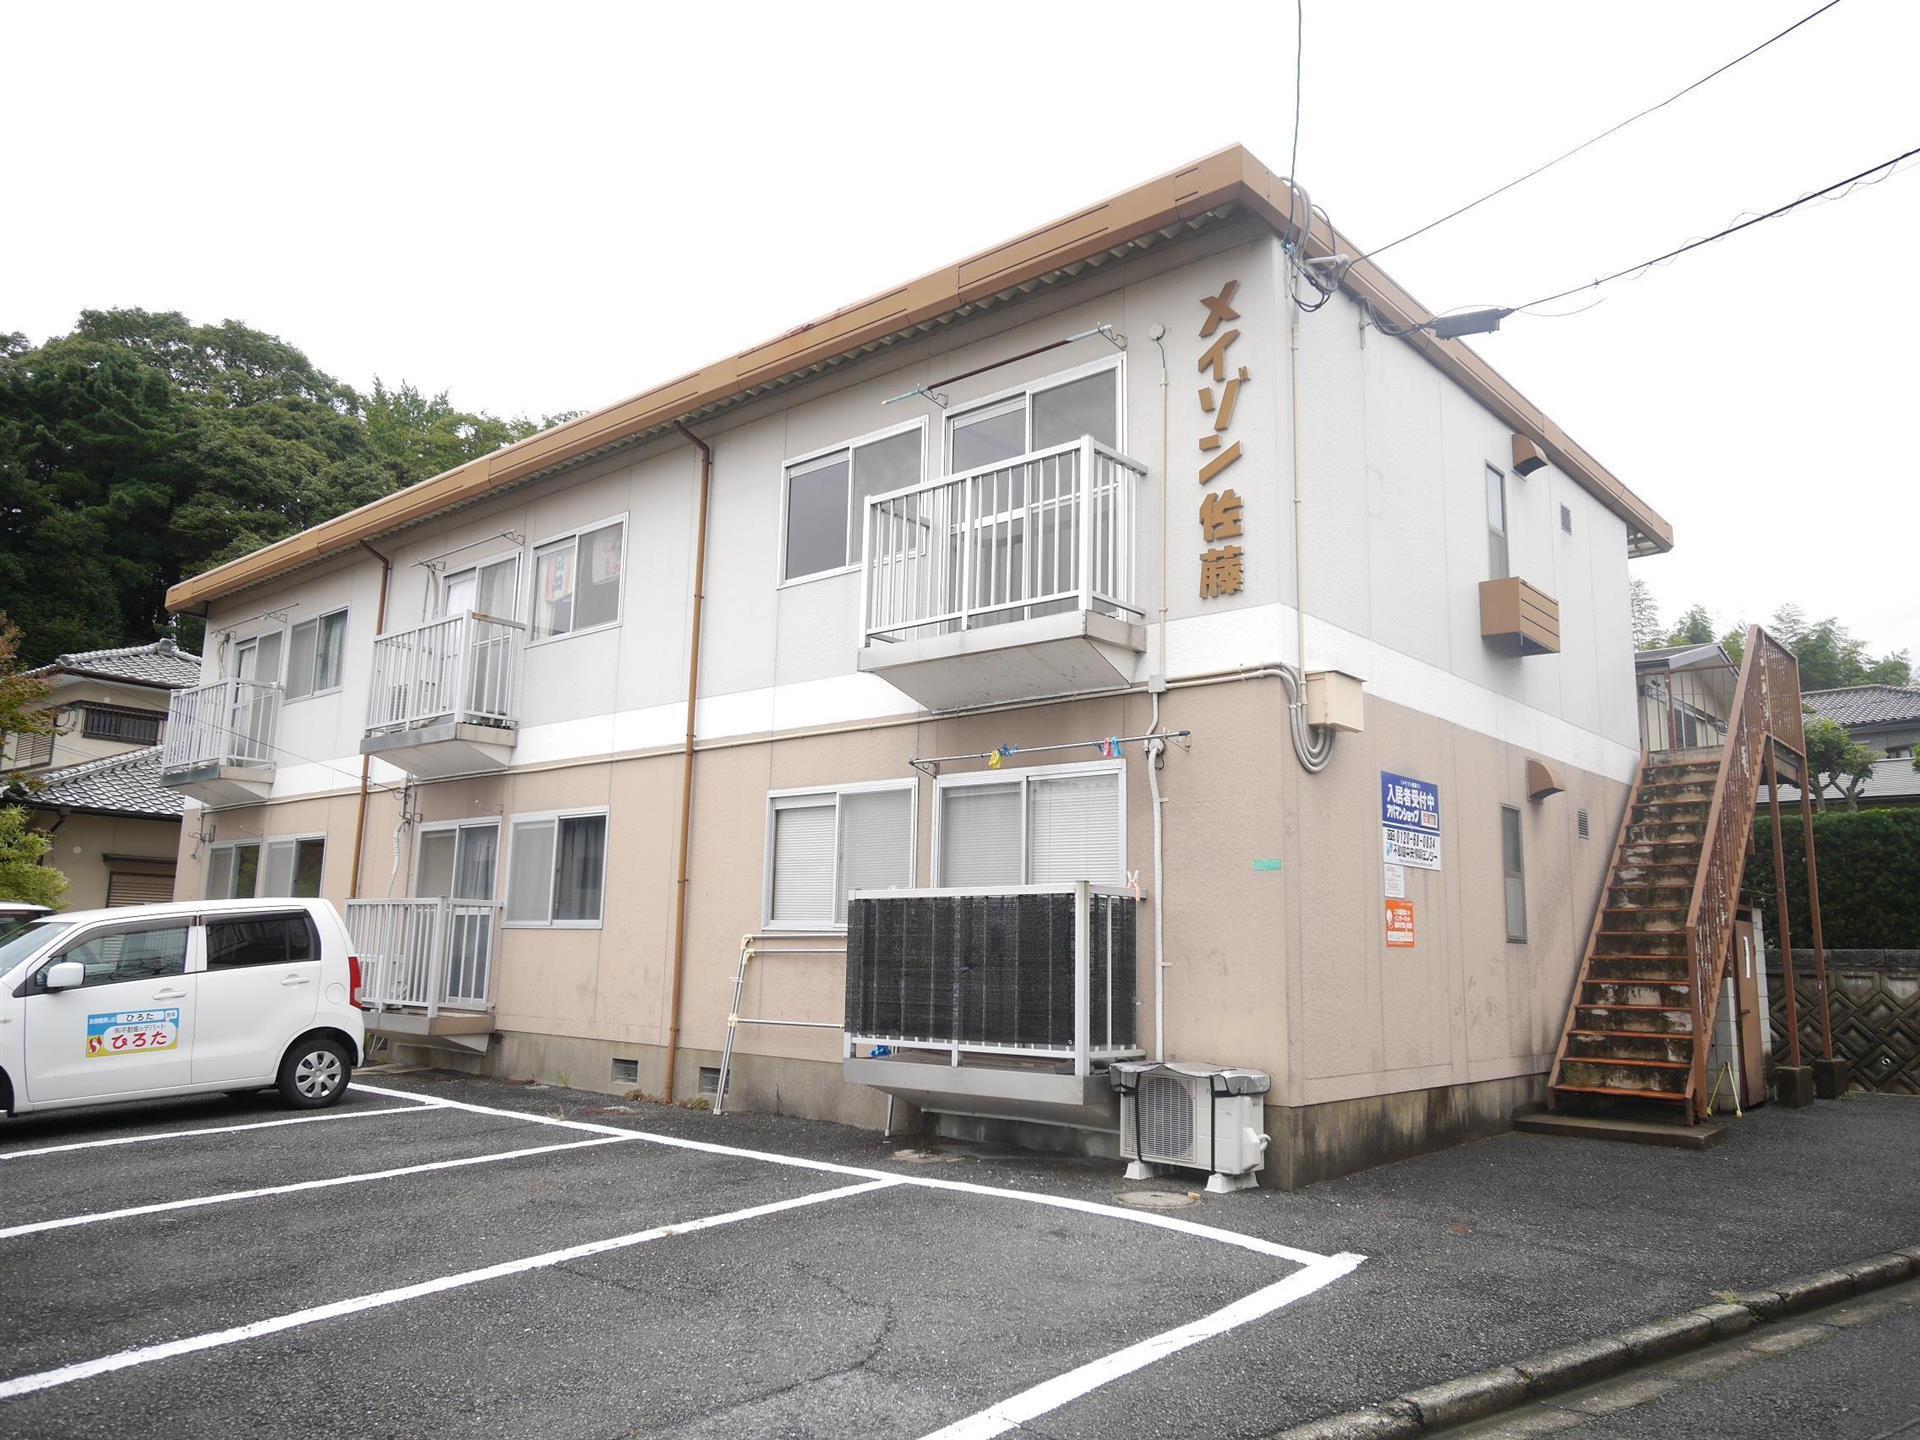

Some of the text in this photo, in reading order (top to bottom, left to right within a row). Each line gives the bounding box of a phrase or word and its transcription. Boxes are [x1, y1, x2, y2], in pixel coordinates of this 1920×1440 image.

[1198, 279, 1250, 599] メイゾン佐藤
[1387, 783, 1435, 811] 入居者受付中
[126, 1012, 155, 1022] ひろた
[111, 1030, 168, 1050] ひろた
